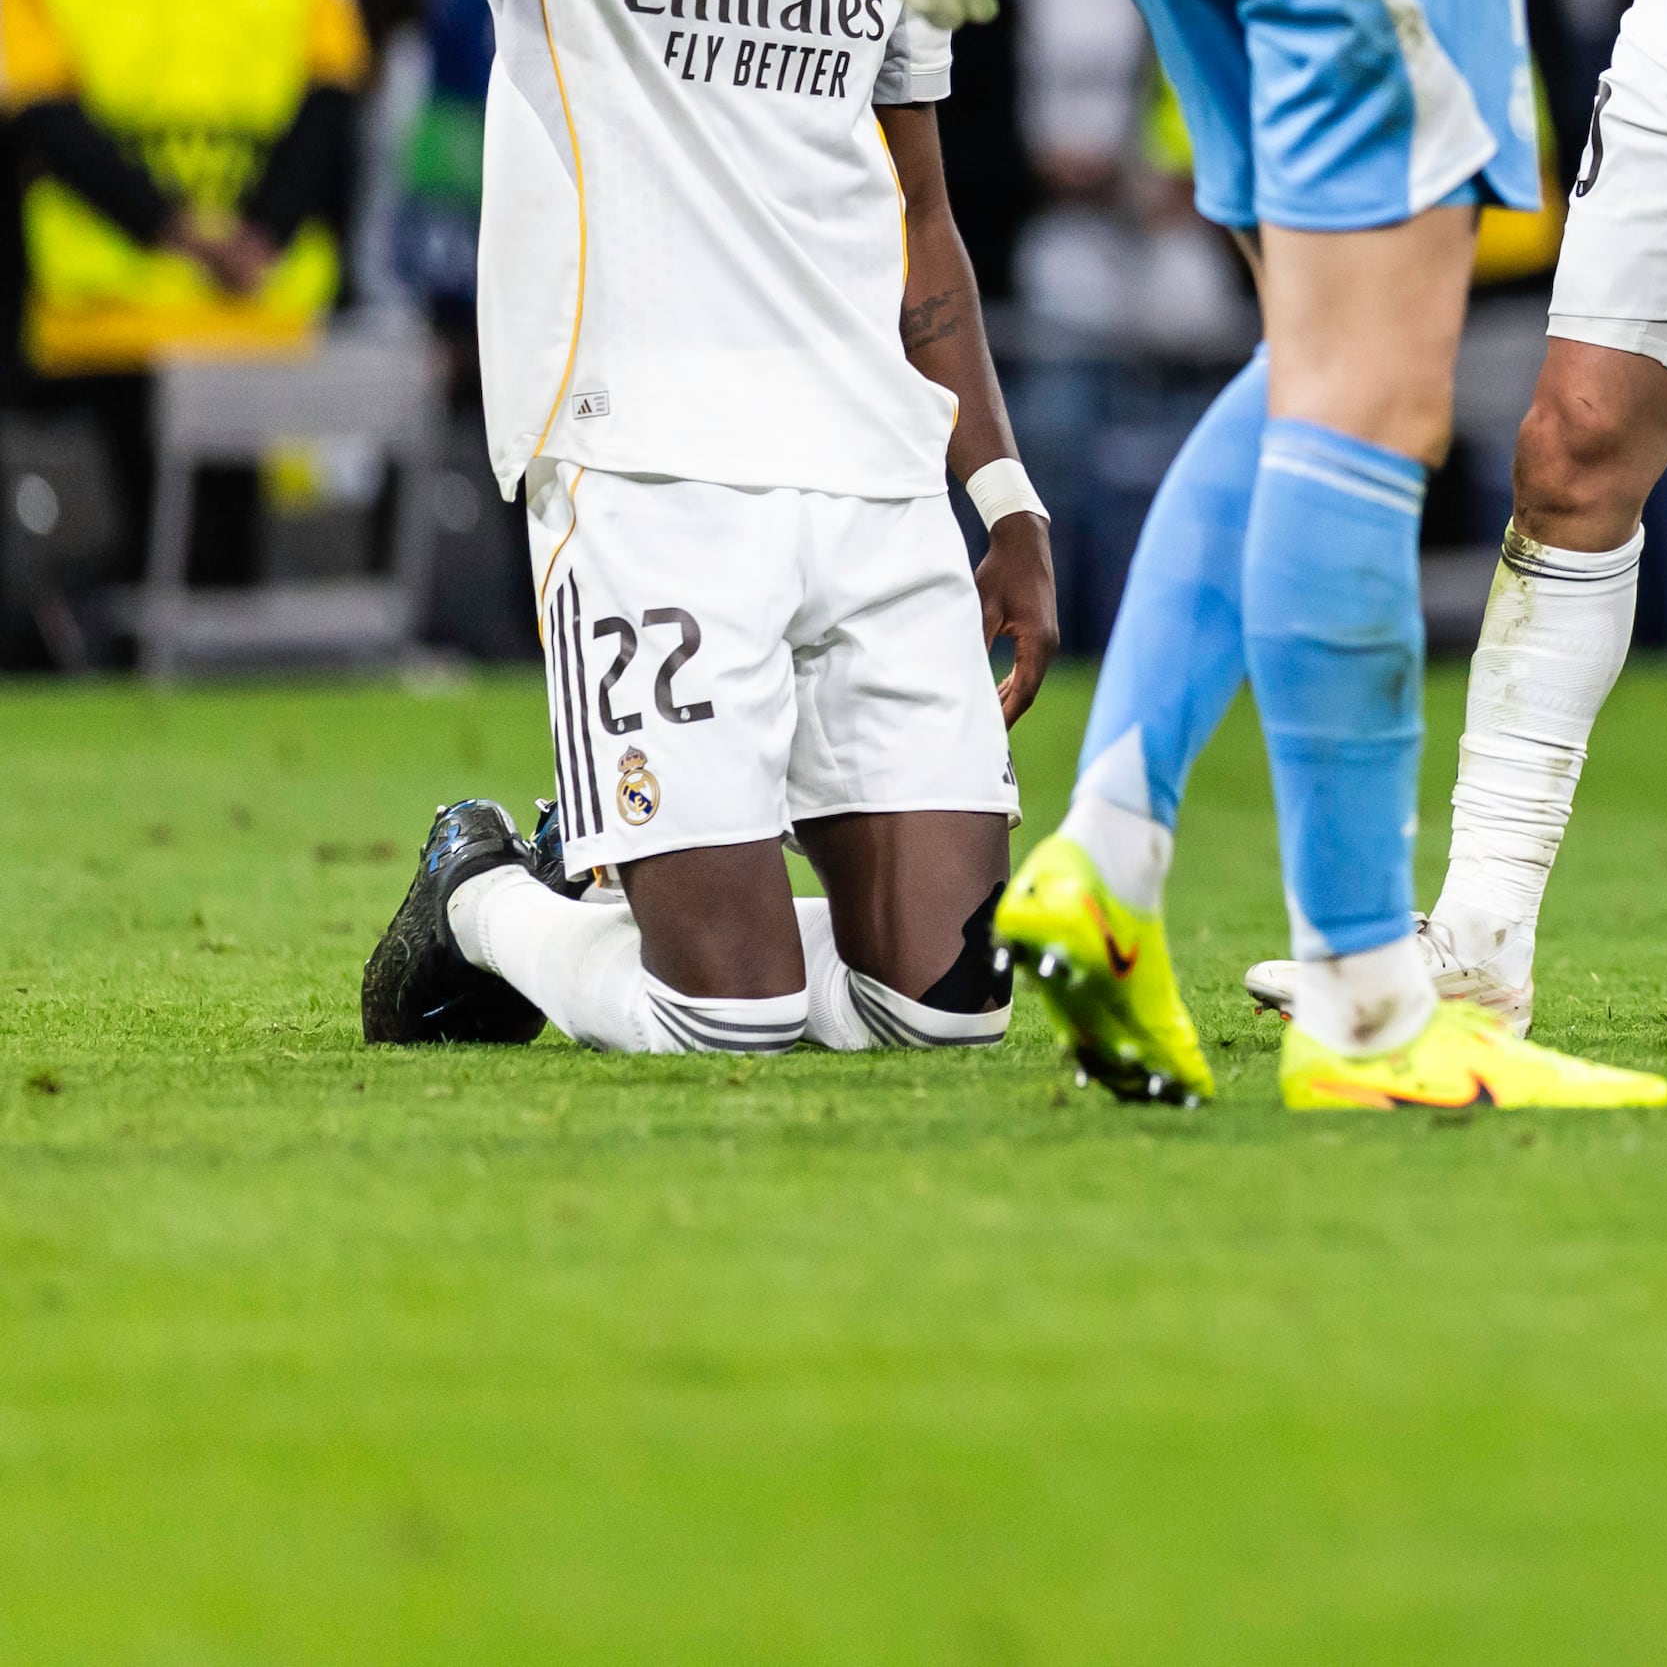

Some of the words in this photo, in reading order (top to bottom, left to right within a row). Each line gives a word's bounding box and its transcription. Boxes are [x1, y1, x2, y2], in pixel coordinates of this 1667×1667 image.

[664, 31, 724, 83] FLY
[733, 39, 851, 98] BETTER
[593, 607, 715, 735] 22
